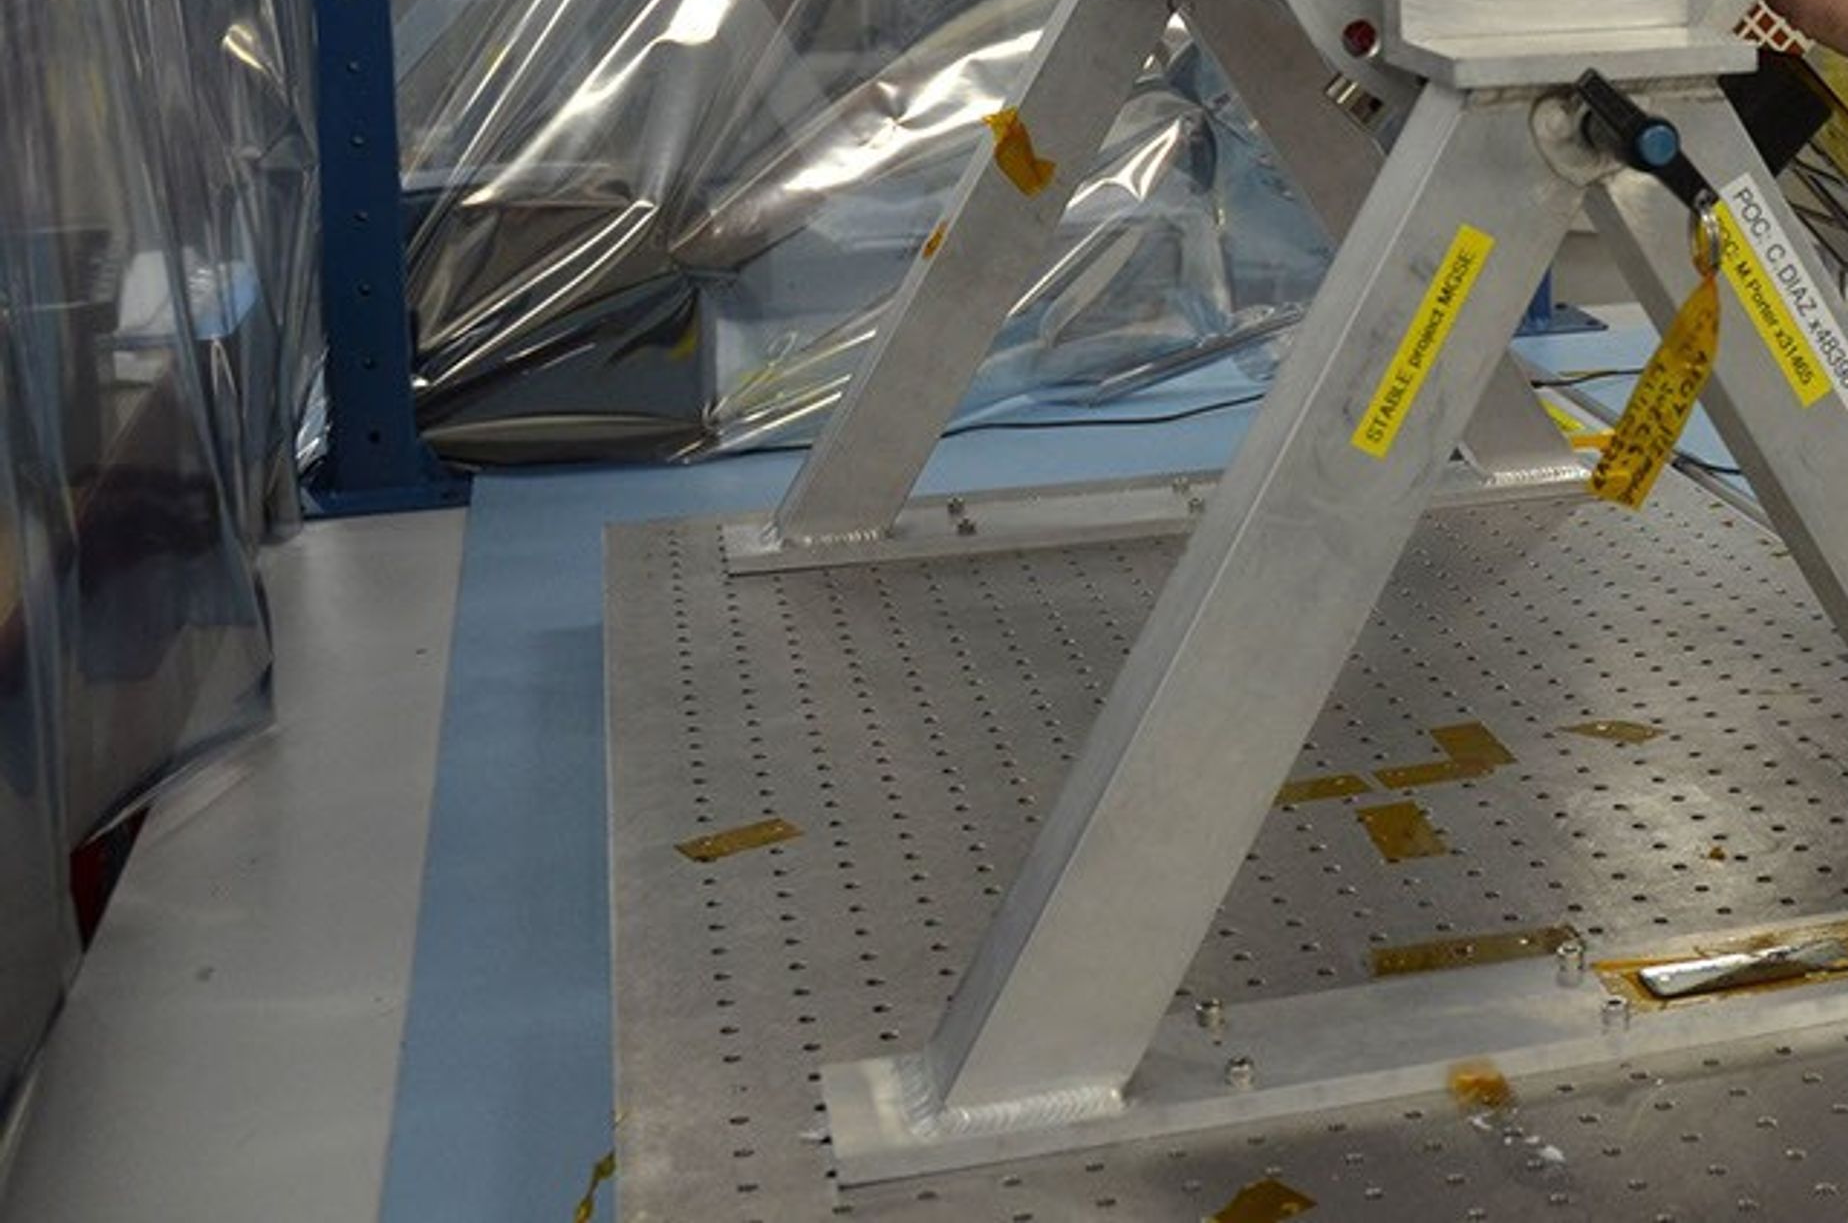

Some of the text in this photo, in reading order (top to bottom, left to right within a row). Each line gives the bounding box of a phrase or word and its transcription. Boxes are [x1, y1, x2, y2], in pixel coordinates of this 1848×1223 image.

[1733, 187, 1773, 244] POC:
[1365, 371, 1412, 443] STABLE
[1407, 309, 1446, 369] project
